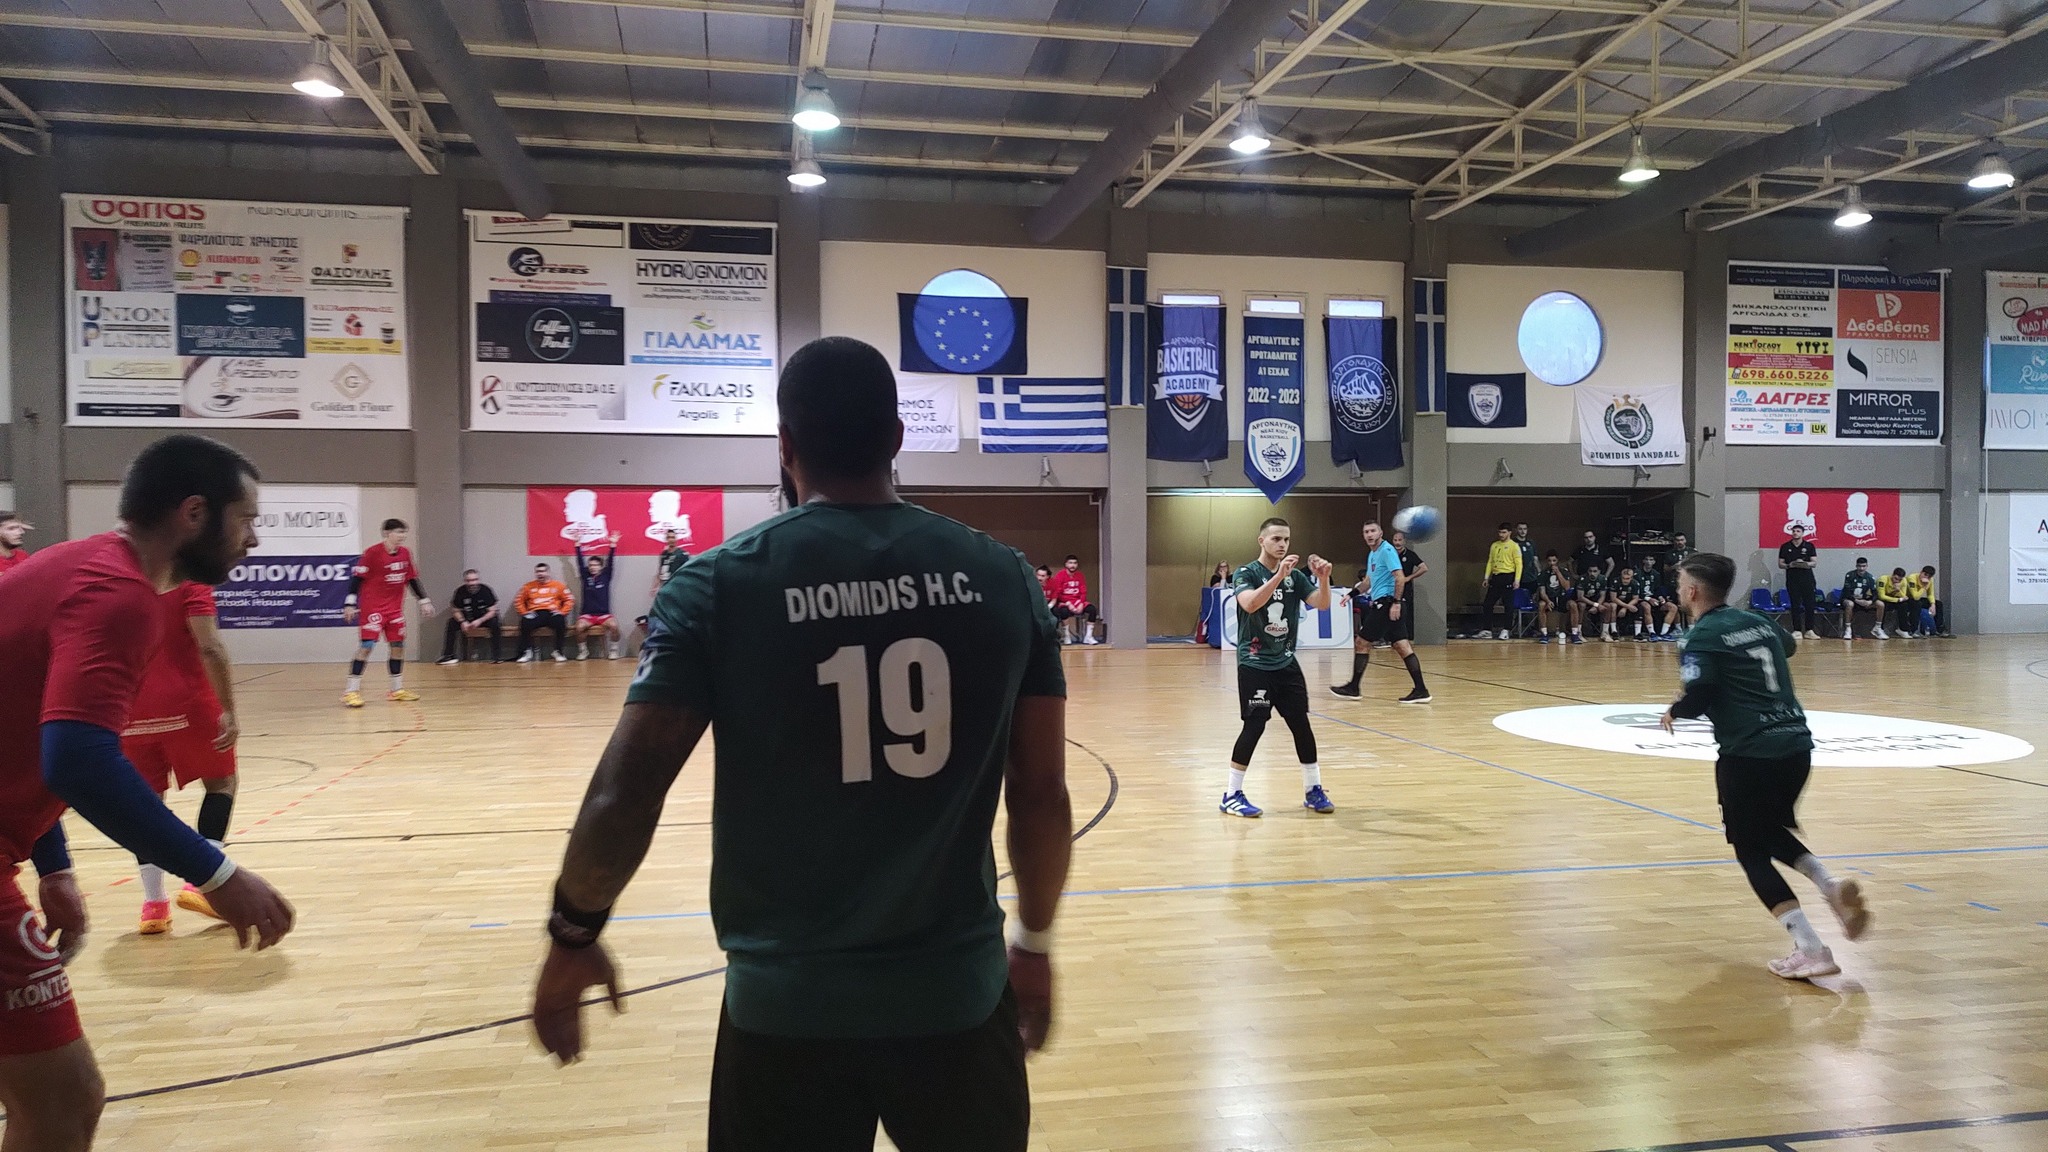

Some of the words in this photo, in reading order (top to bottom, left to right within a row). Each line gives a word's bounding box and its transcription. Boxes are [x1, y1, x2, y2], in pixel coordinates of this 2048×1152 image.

[311, 266, 393, 280] ΦΑΣΟΥΛΗΣ
[1846, 318, 1930, 334] Δεδεβέσης
[2021, 321, 2040, 333] MAD
[644, 331, 762, 350] ΓΙΑΛΑΜΑΣ
[1247, 335, 1290, 346] ΑΡΓΟΝΑΥΤΗΣ
[1157, 346, 1219, 375] BASKETBALL
[1250, 350, 1298, 361] ΠΡΩΤΑΘΛΗΤΗΣ
[1876, 348, 1918, 364] SENSIA
[1334, 359, 1388, 380] ΑΡΓΟΝΑΥΤΗΣ
[1742, 369, 1829, 380] 698.660.5226
[669, 381, 754, 398] FAKLARIS
[1165, 378, 1211, 391] ACADEMY
[1247, 387, 1270, 403] 2022
[1278, 388, 1300, 404] 2023
[1754, 392, 1831, 406] ΔΑΓΡΕΣ
[1849, 393, 1913, 407] MIRROR
[898, 400, 934, 409] ΗΜΟΣ
[677, 409, 719, 421] Argolis
[898, 412, 937, 421] ΡΓΟΥΣ
[1897, 408, 1927, 416] PLUS
[907, 425, 954, 433] ΚΗΝΩΝ
[1252, 421, 1297, 432] ΑΡΓΟΝΑΥΤΗΣ
[1590, 451, 1630, 459] DIOMIDIS
[1633, 451, 1680, 459] HANDBALL
[284, 511, 348, 528] ΜΟΡΙΑ
[228, 564, 350, 582] ΟΠΟΥΛΟΣ
[785, 575, 918, 623] DIOMIDIS
[923, 571, 983, 606] H.C.
[1745, 645, 1781, 694] 7
[815, 637, 953, 784] 19
